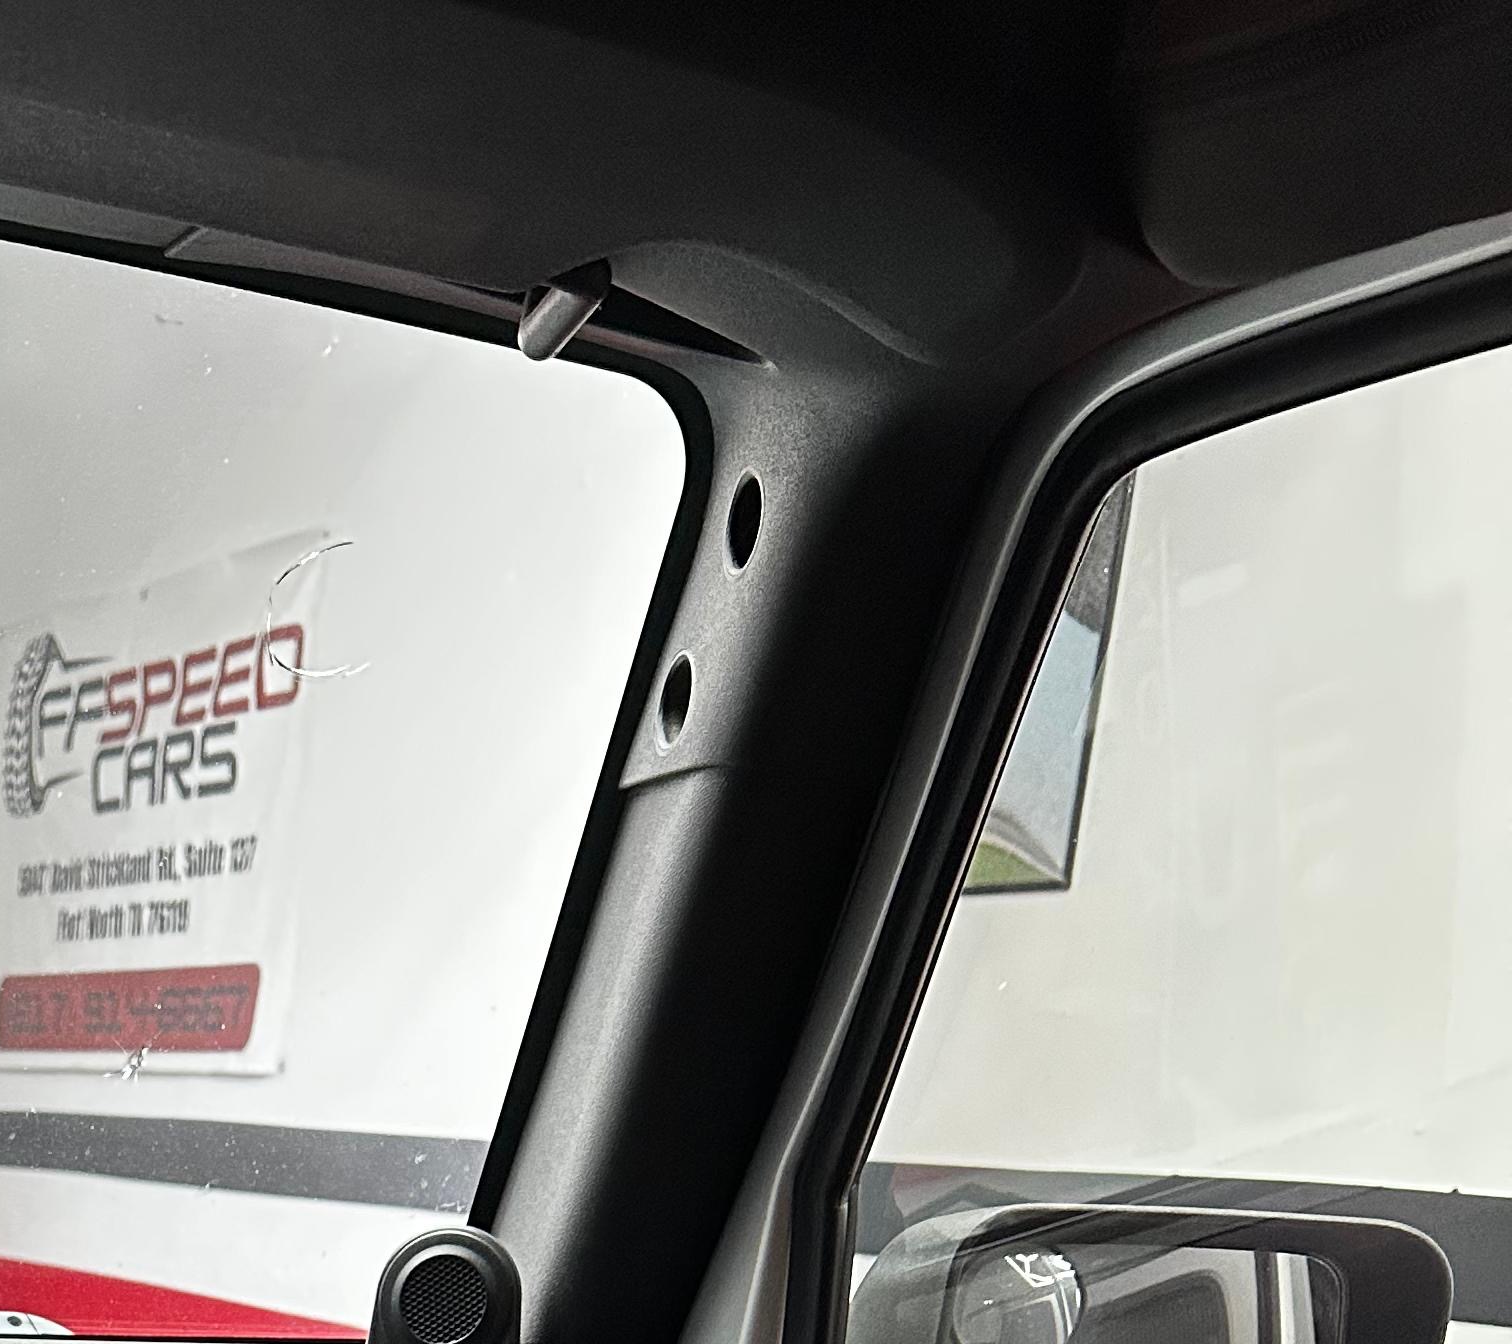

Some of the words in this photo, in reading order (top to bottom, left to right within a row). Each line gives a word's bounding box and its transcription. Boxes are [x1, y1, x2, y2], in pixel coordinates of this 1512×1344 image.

[91, 719, 238, 814] CARS
[87, 850, 153, 890] Strickland
[184, 840, 223, 878] Suite
[88, 903, 124, 940] Worth
